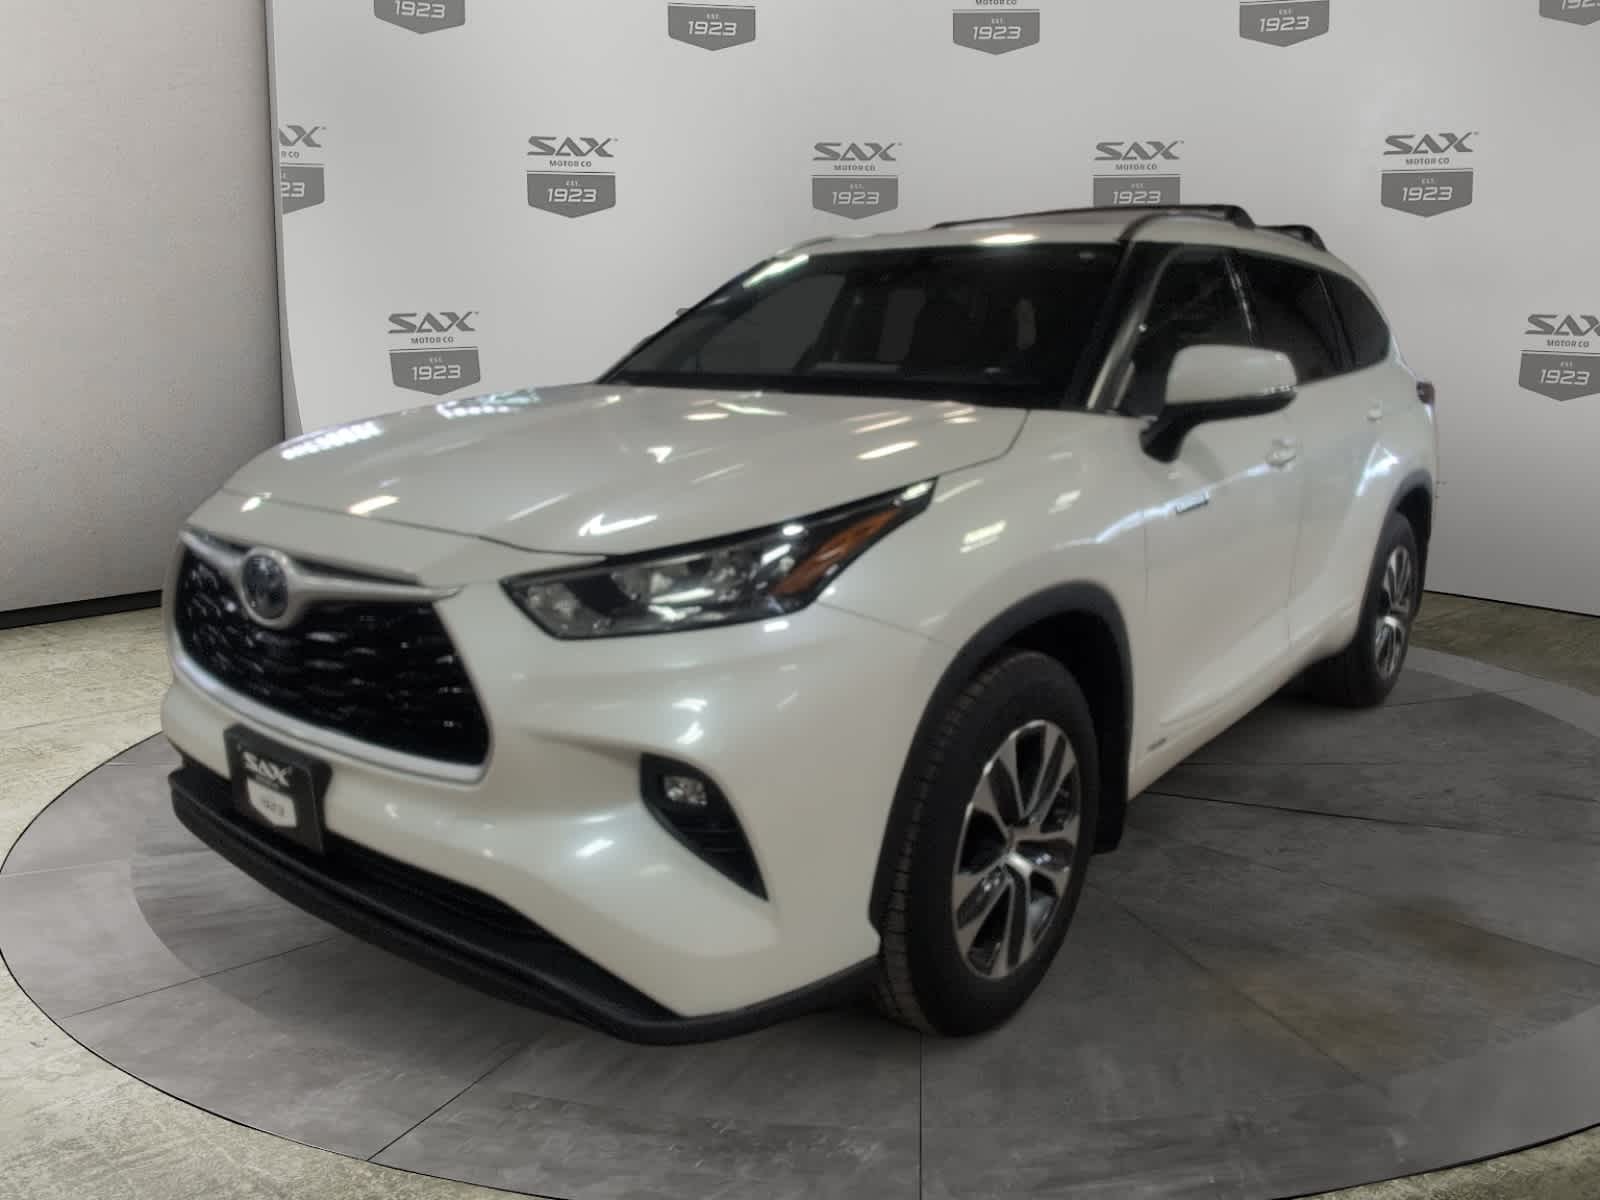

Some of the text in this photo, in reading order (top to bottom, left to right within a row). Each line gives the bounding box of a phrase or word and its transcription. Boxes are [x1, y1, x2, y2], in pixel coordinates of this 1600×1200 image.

[395, 0, 445, 18] 1923
[688, 21, 737, 36] 1923
[1260, 16, 1309, 32] 1923
[973, 26, 1021, 40] 1923
[527, 135, 614, 157] SAX
[813, 142, 897, 161] SAX
[1094, 140, 1180, 161] SAX
[1383, 132, 1473, 155] SAX
[281, 182, 305, 197] 23
[548, 188, 597, 203] 1923
[1113, 190, 1161, 205] 1923
[1403, 186, 1453, 201] 1923
[832, 191, 880, 205] 1923
[387, 311, 475, 334] SAX
[1524, 314, 1600, 336] SAX
[1578, 340, 1590, 348] CO
[412, 364, 461, 381] 1923
[1540, 369, 1590, 385] 1923
[243, 751, 289, 787] SAX
